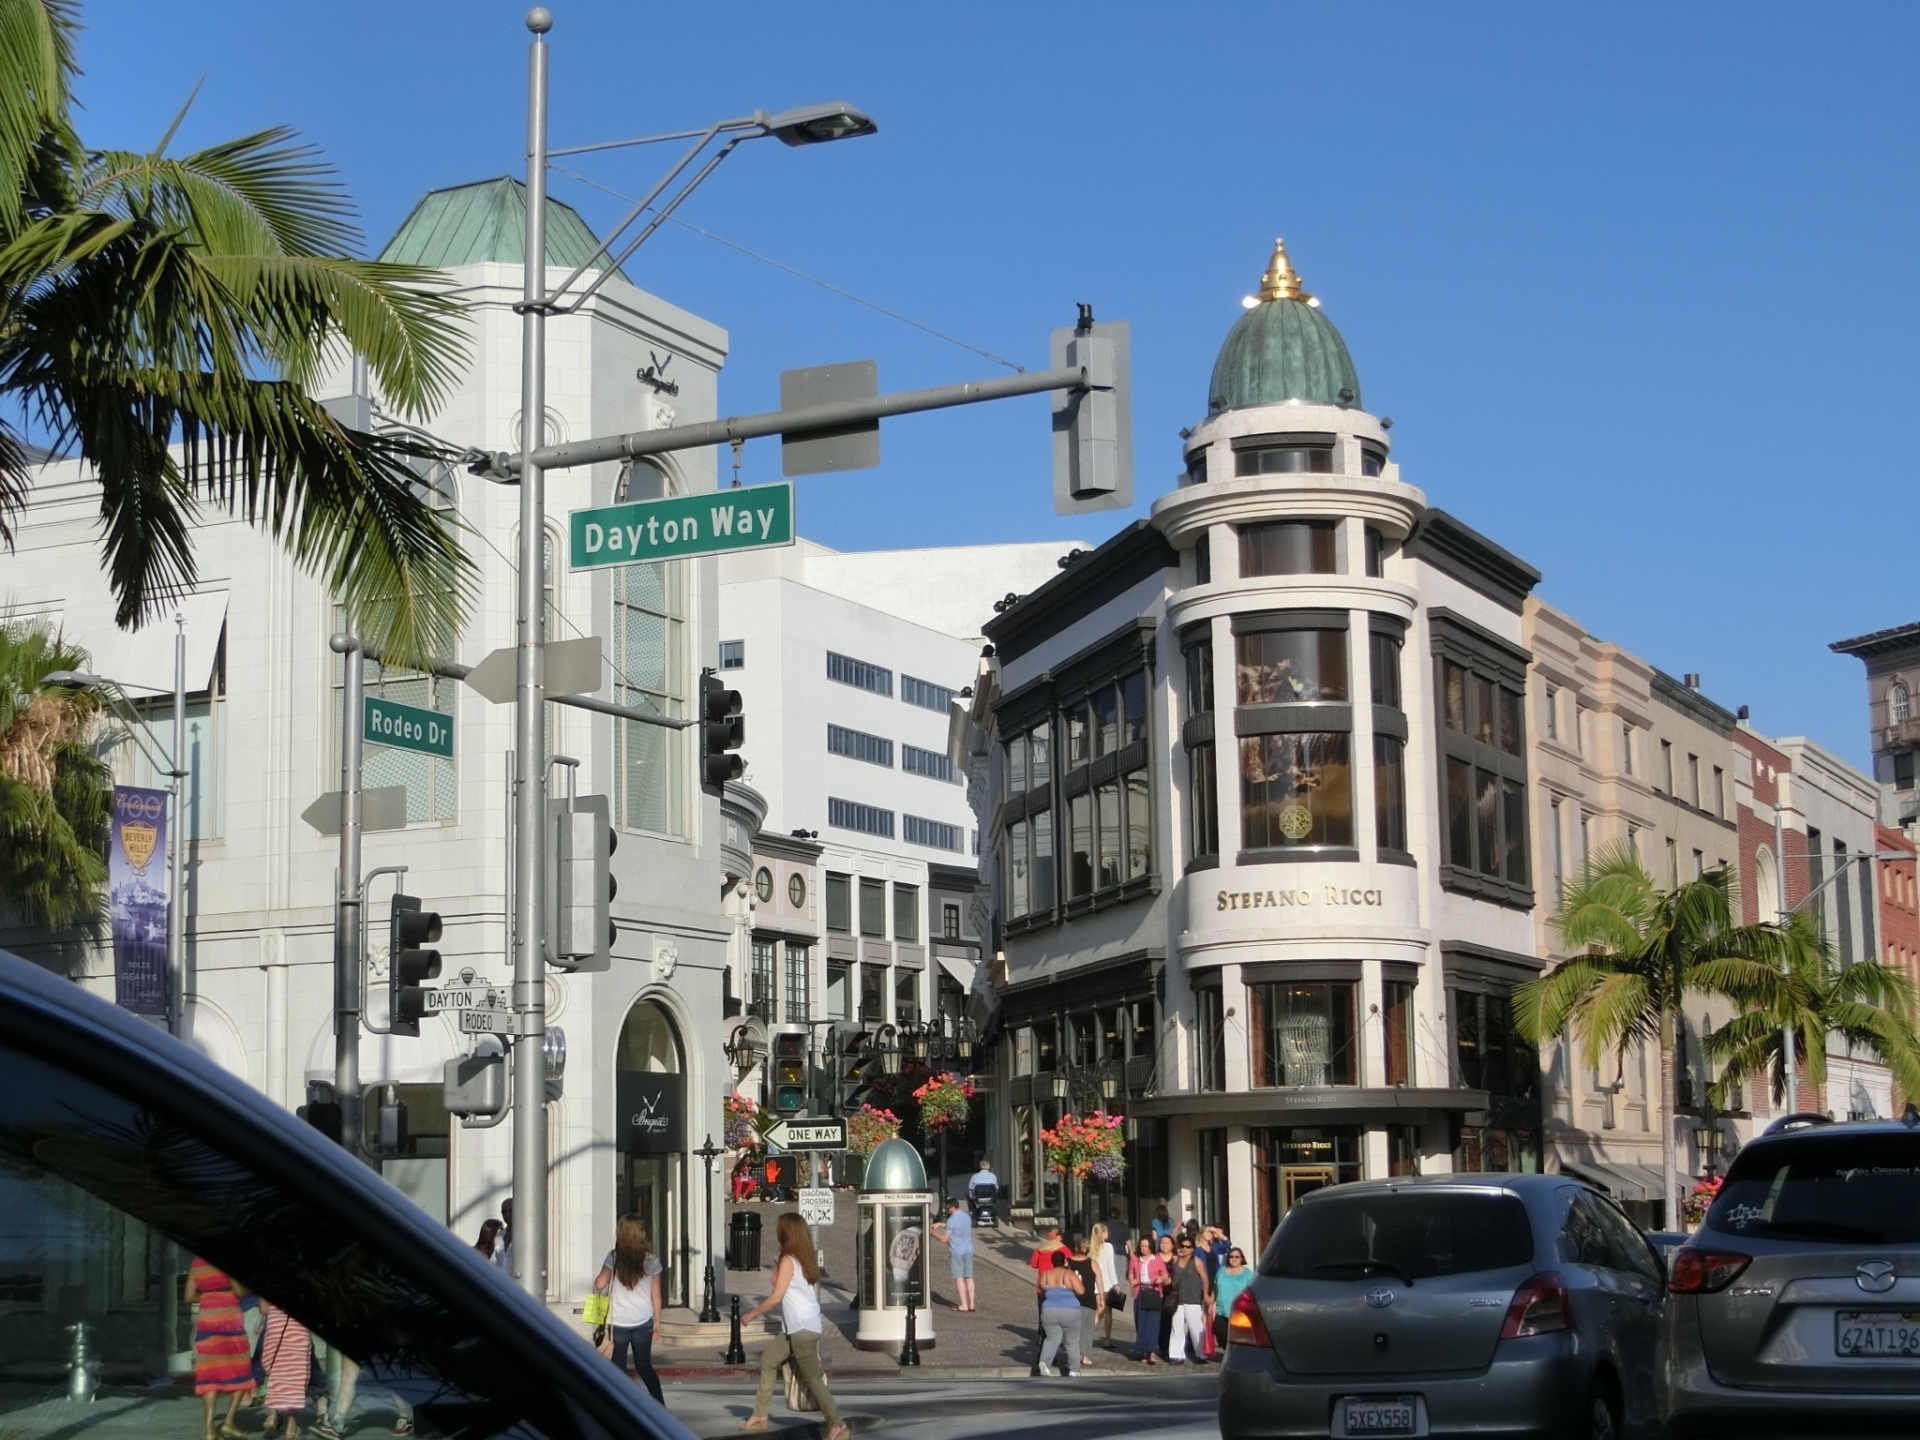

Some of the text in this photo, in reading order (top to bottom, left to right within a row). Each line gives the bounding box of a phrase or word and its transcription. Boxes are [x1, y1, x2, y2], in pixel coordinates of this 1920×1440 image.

[585, 505, 775, 556] Dayton Way
[372, 708, 447, 746] Rodeo Dr
[115, 793, 164, 812] Centennial
[125, 832, 153, 843] BEVERLY
[129, 844, 148, 853] HILLS
[1216, 885, 1383, 911] STEFANO RICCI
[122, 972, 157, 981] GEARYS
[429, 991, 472, 1007] DAYTON
[465, 1013, 492, 1030] RODEO
[788, 1129, 837, 1140] ONE WAY
[801, 1189, 831, 1197] DIAGONAL
[801, 1209, 813, 1220] OK
[1842, 1328, 1919, 1349] 6ZAT196
[1349, 1409, 1410, 1428] 5XEX558
